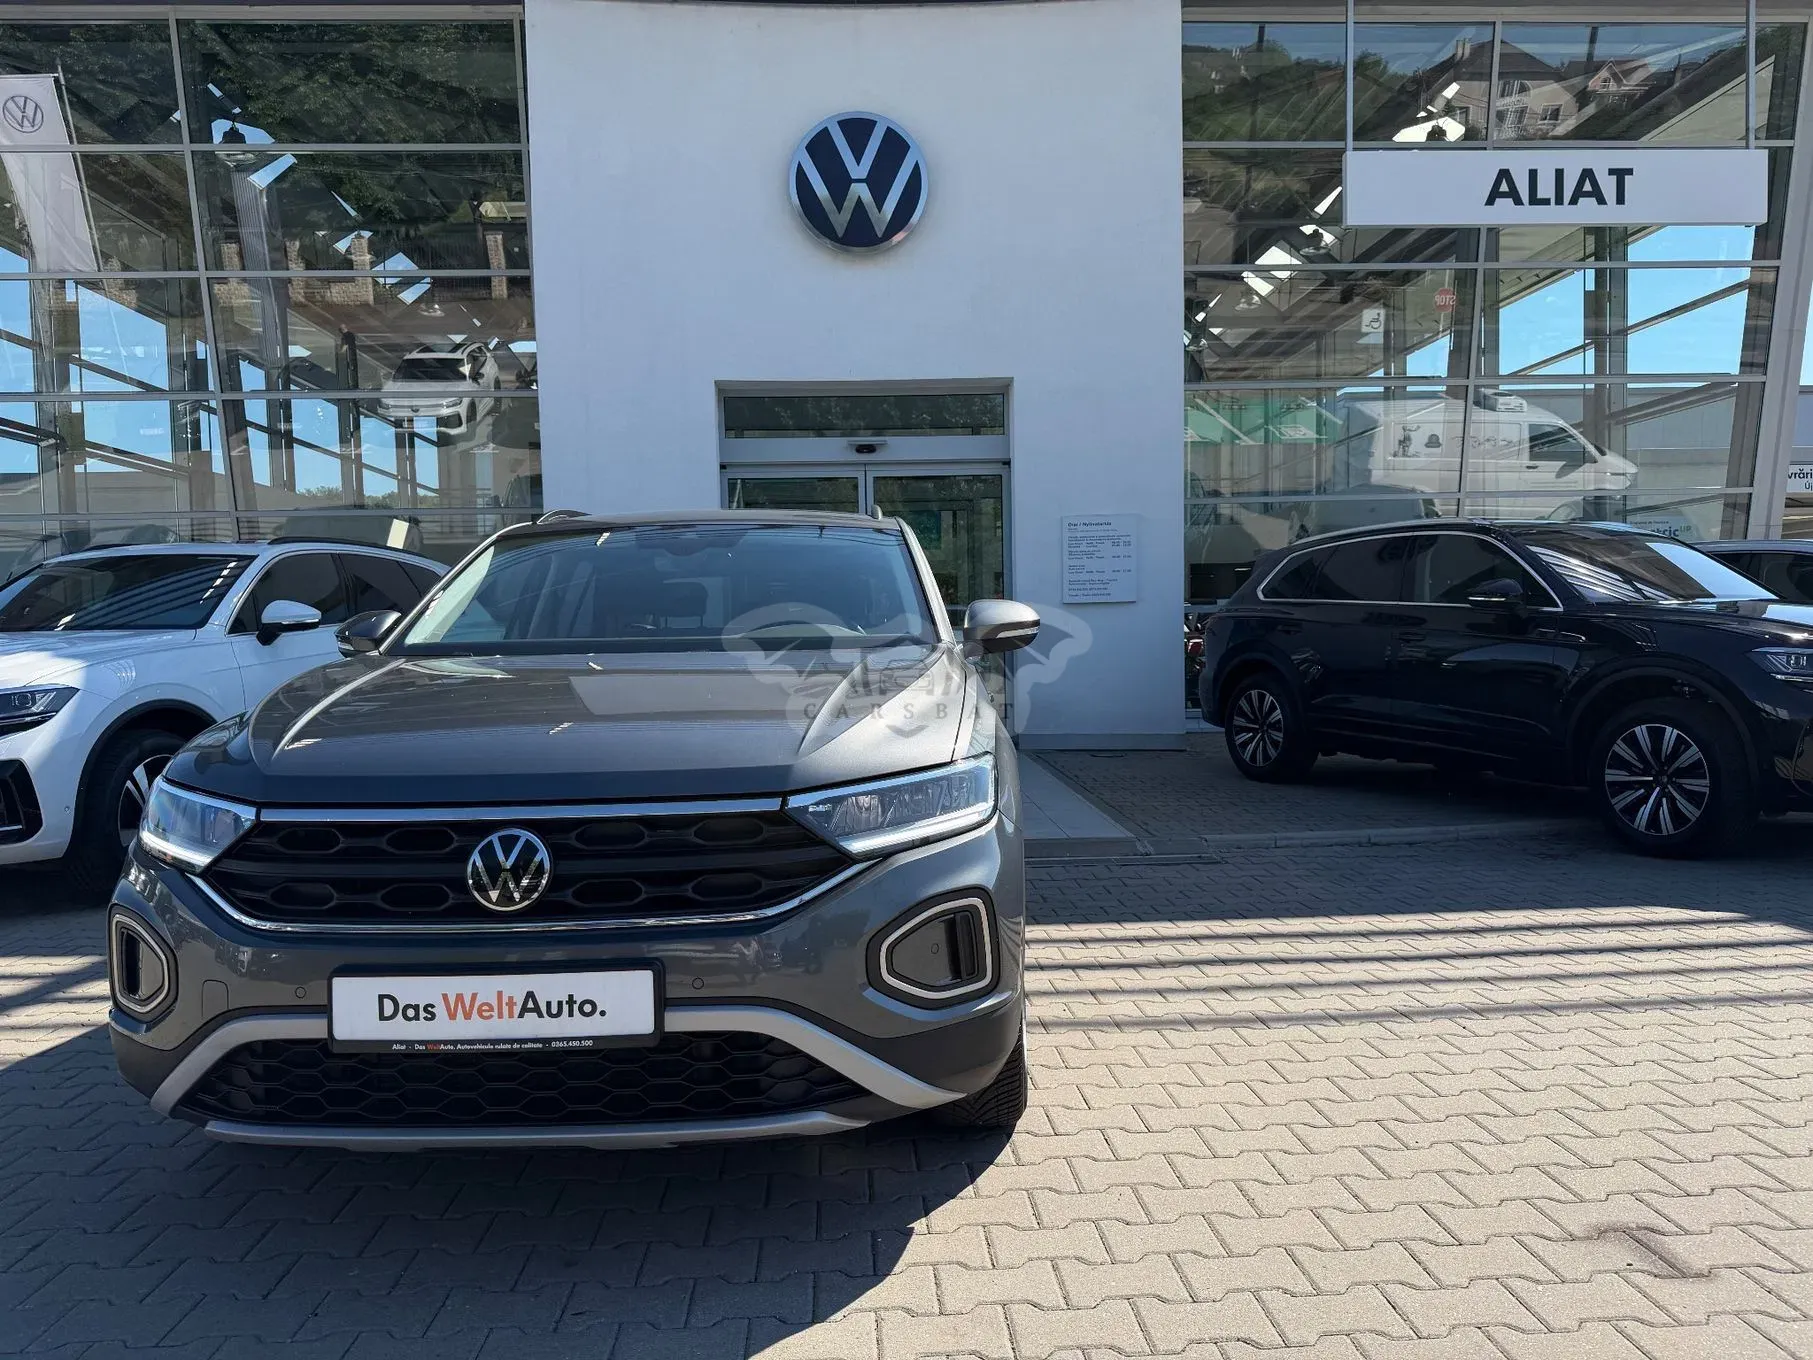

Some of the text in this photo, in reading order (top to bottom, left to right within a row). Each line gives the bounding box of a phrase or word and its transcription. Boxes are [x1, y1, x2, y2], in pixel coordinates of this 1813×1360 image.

[1484, 167, 1634, 207] ALIAT
[377, 990, 607, 1022] Das WeltAuto.
[414, 1043, 426, 1051] Das
[494, 1041, 512, 1050] rulate
[513, 1041, 521, 1049] de
[521, 1040, 543, 1049] calitate
